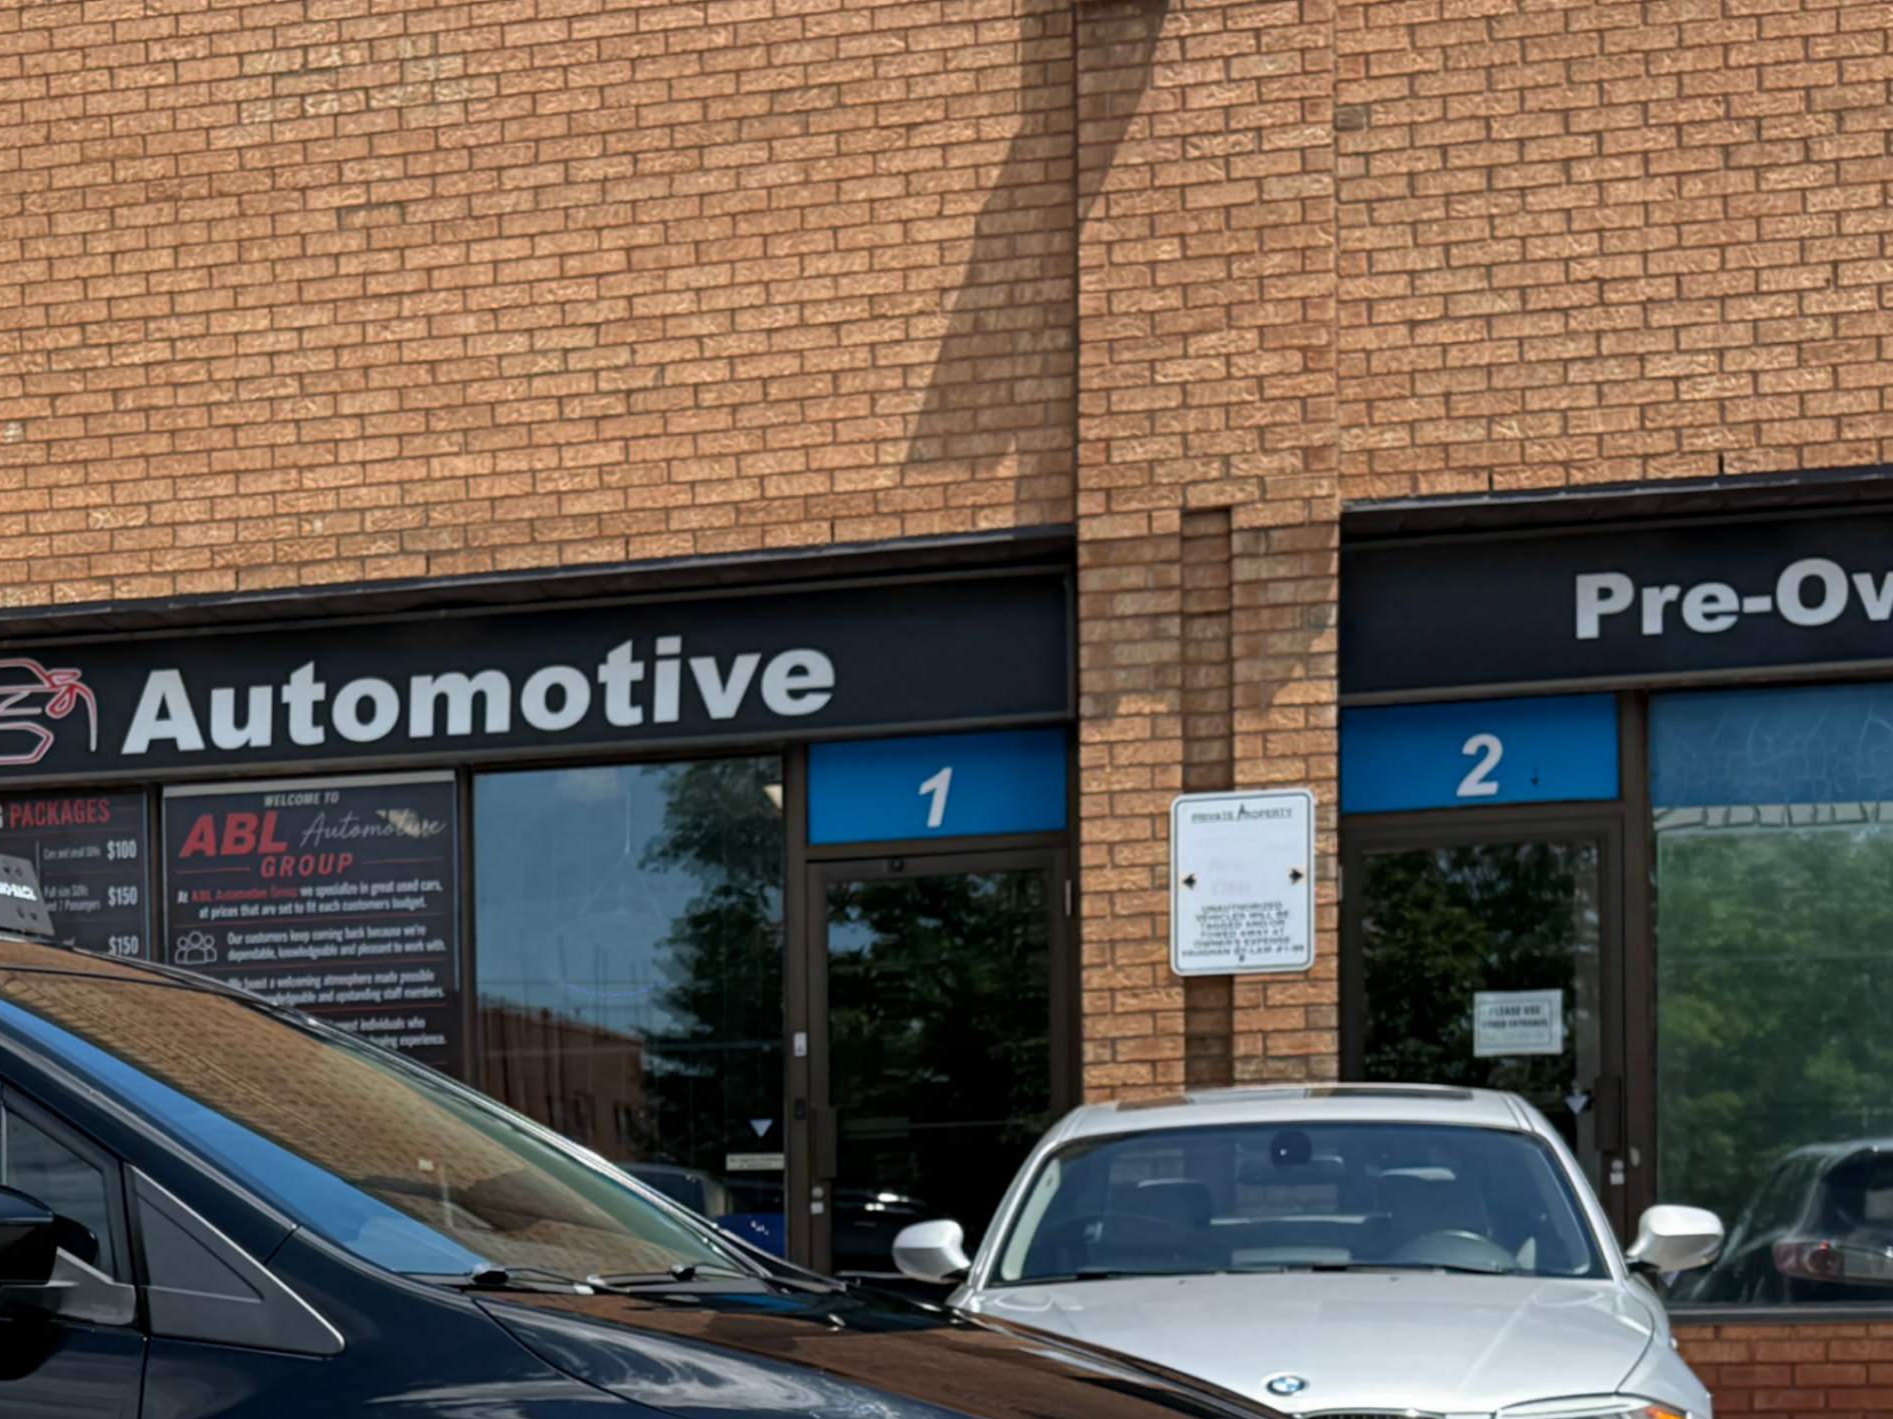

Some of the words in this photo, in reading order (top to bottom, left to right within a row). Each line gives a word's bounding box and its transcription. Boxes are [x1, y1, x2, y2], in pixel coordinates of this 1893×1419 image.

[121, 636, 835, 754] Automotive
[1456, 733, 1503, 797] 2
[264, 792, 320, 807] WELCOME
[323, 791, 340, 804] TO
[918, 766, 952, 828] 1
[9, 799, 112, 829] PACKAGES
[1237, 808, 1293, 821] ROPERTY
[179, 810, 288, 858] ABL
[299, 810, 447, 848] Automotive
[107, 840, 137, 860] $100
[260, 853, 354, 878] GROUP
[107, 886, 138, 907] $150
[108, 936, 139, 956] $150
